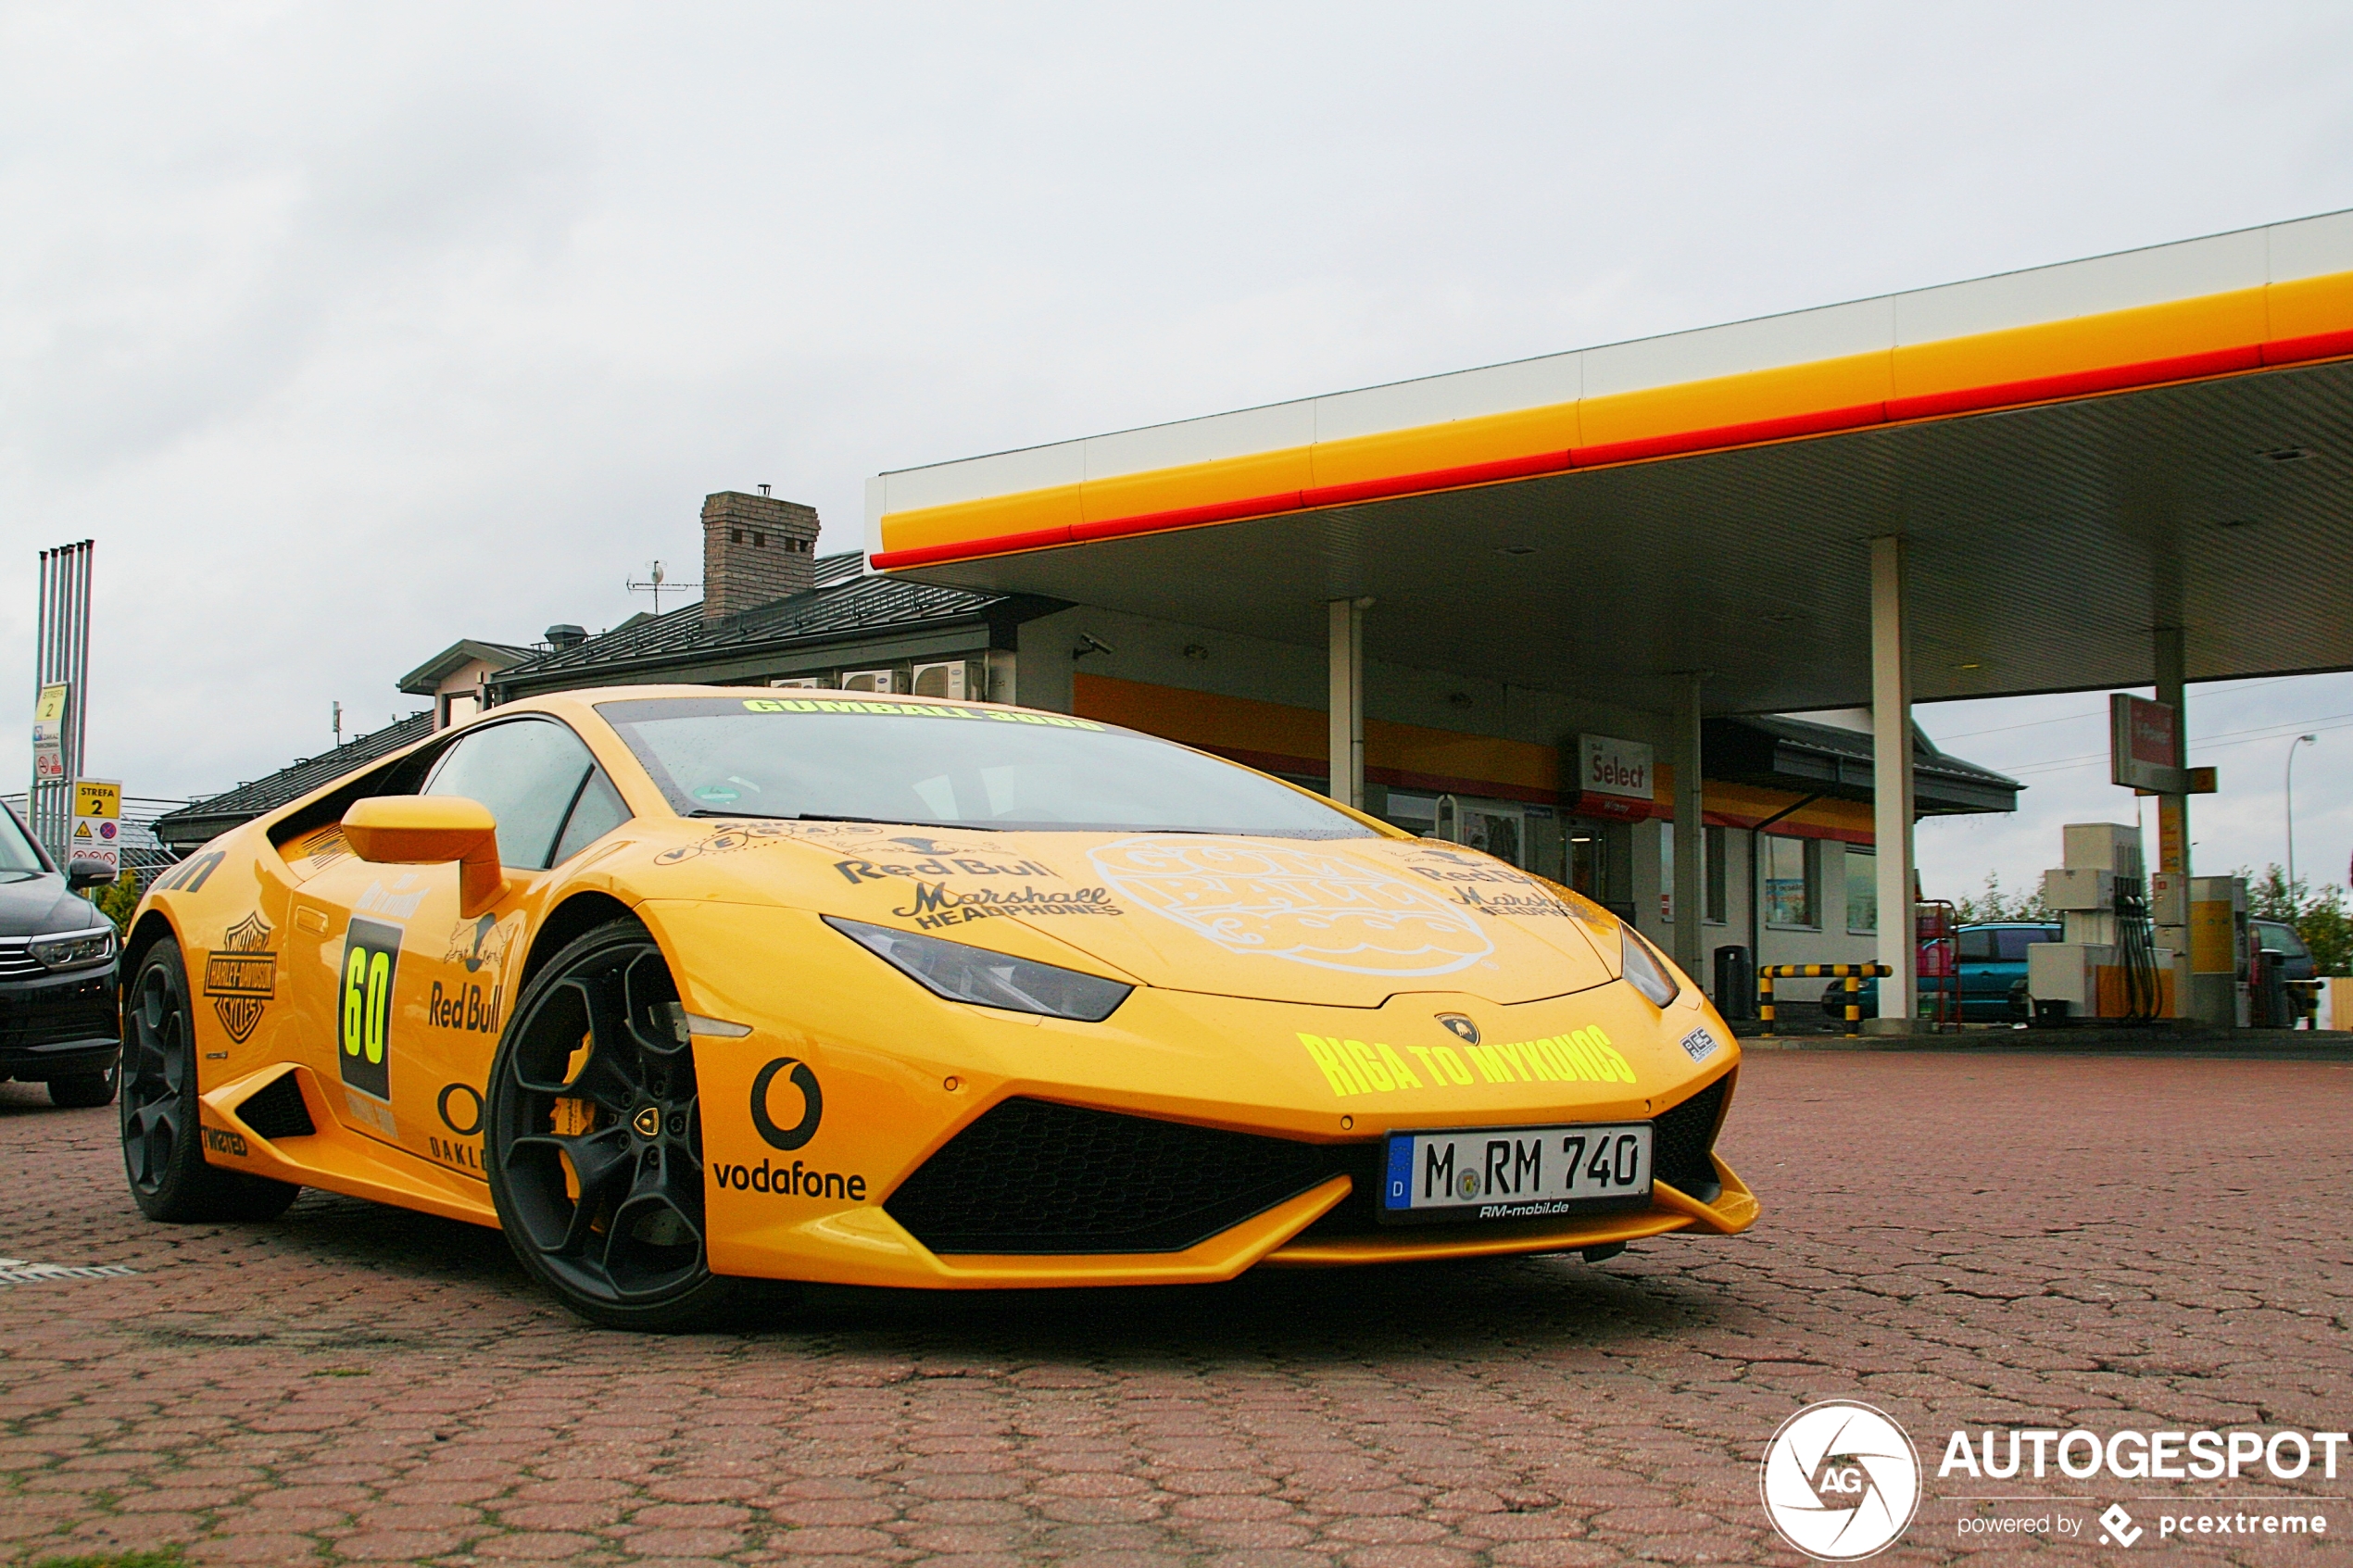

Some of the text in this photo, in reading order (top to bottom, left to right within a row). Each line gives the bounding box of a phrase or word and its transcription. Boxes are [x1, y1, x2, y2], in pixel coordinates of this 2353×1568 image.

[45, 703, 54, 717] 2
[742, 699, 1106, 732] GUMBALL 3000
[1592, 754, 1644, 788] Select
[82, 787, 115, 797] STREFA
[91, 799, 103, 815] 2
[834, 858, 1064, 884] Red Bull
[892, 881, 1112, 917] Marshall
[914, 903, 1125, 930] HEADPHONES
[231, 926, 264, 952] MOTOR
[209, 960, 272, 988] HARLEY-DAVIDSON
[223, 997, 258, 1034] CYCLES
[344, 947, 390, 1064] 60
[429, 981, 503, 1034] Red Bull
[1295, 1024, 1637, 1097] RIGA TO MYKONOS
[429, 1136, 487, 1171] OAKLE
[1425, 1134, 1639, 1198] M RM 740
[712, 1158, 866, 1201] vodafone
[1392, 1181, 1403, 1197] D
[1479, 1201, 1569, 1219] RM-mobil.de
